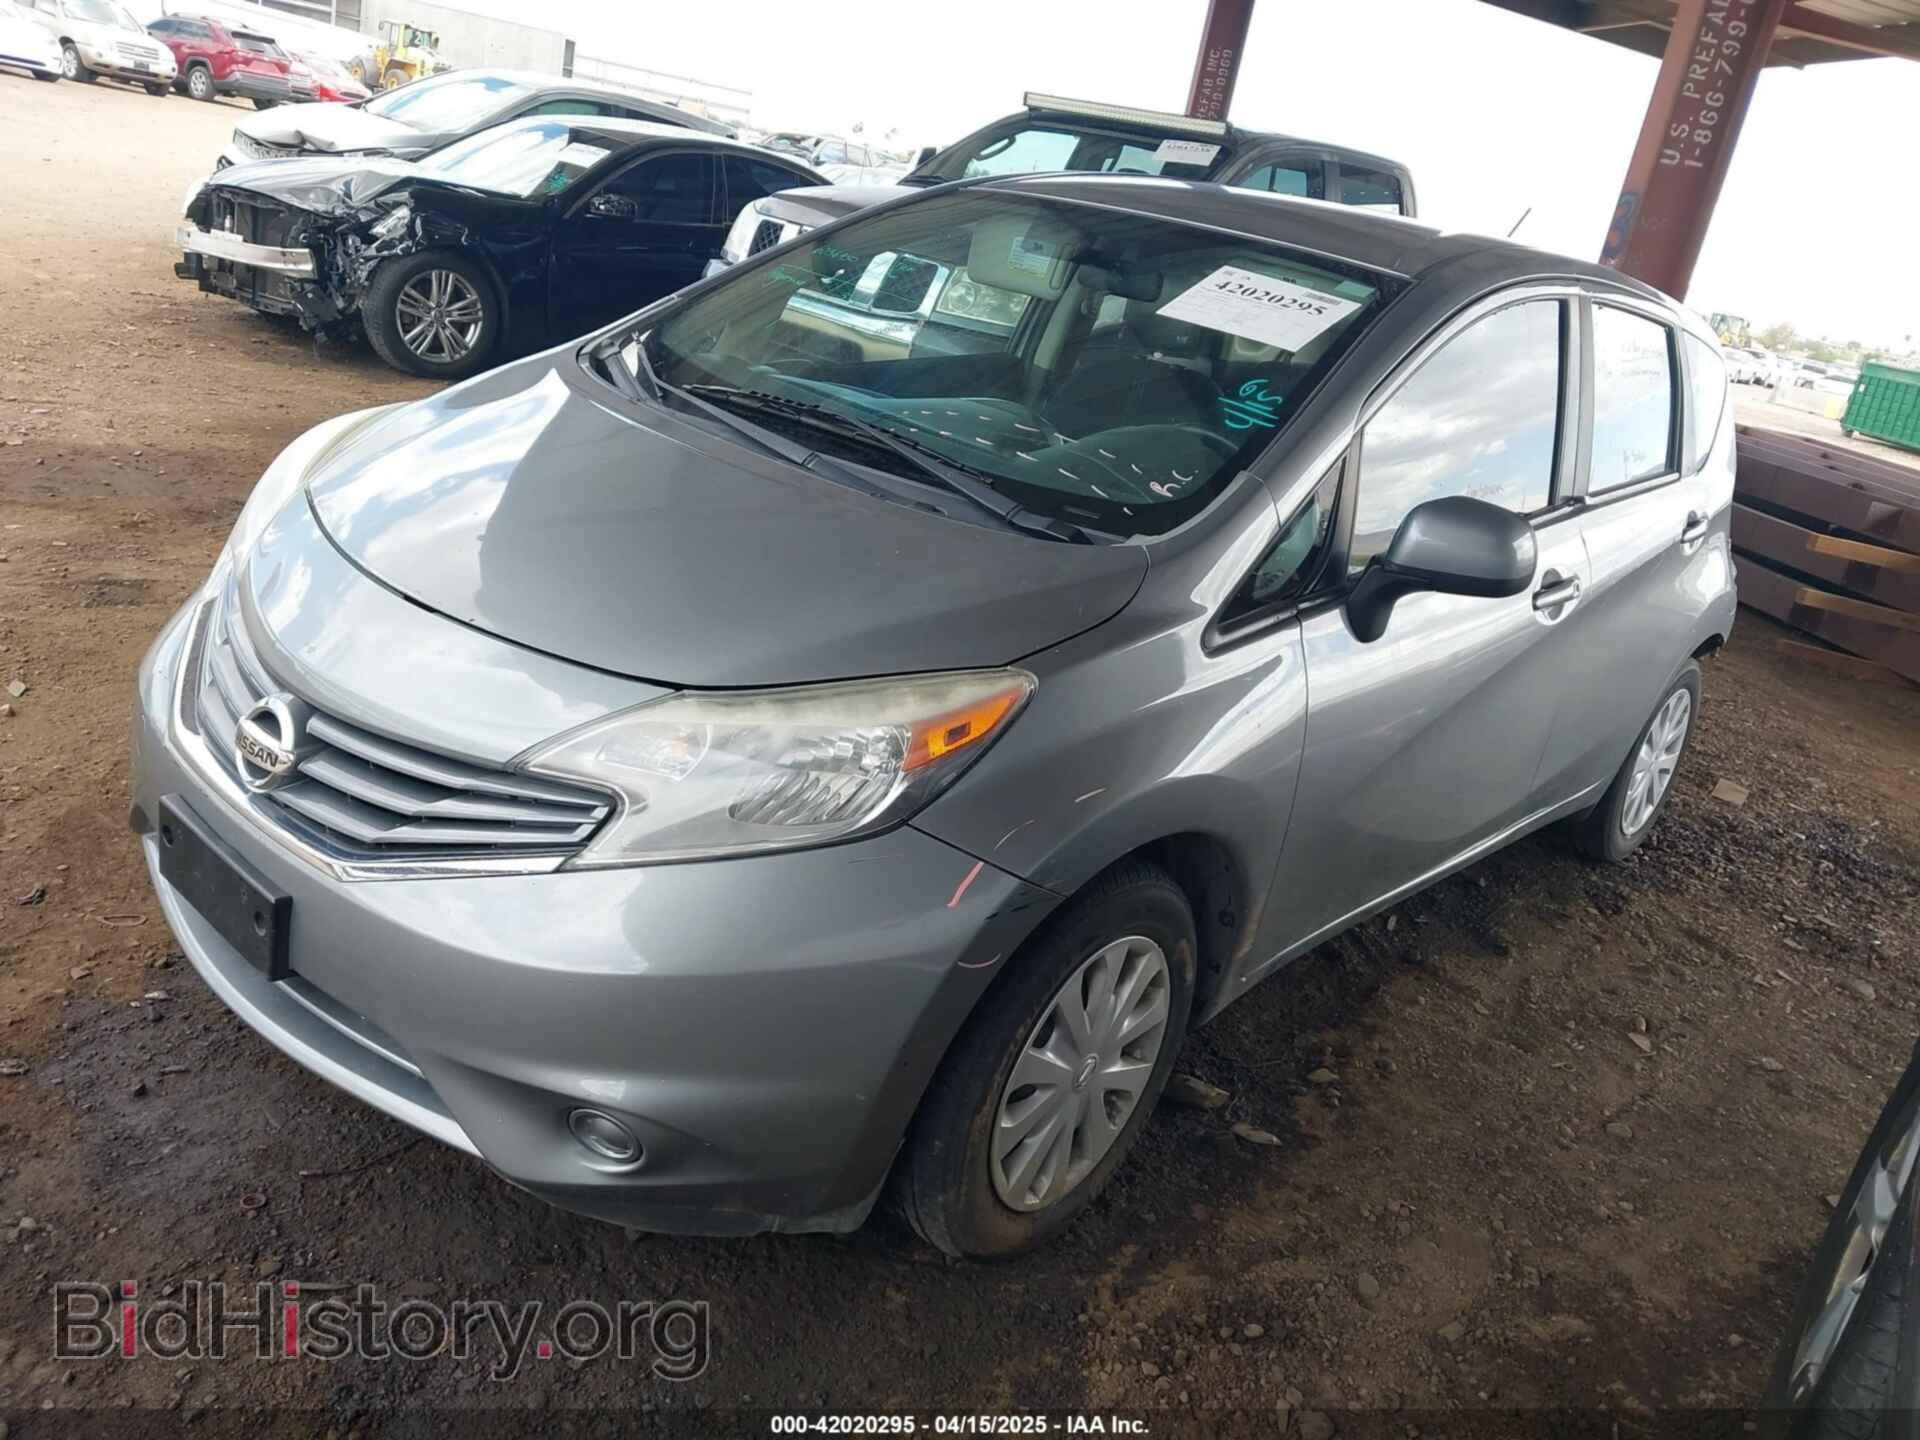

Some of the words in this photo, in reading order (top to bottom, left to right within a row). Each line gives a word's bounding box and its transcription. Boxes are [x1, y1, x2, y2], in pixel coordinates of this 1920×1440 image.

[1684, 0, 1755, 168] 1-866-799-
[1660, 116, 1693, 165] U.S.
[1214, 281, 1327, 317] 42020295
